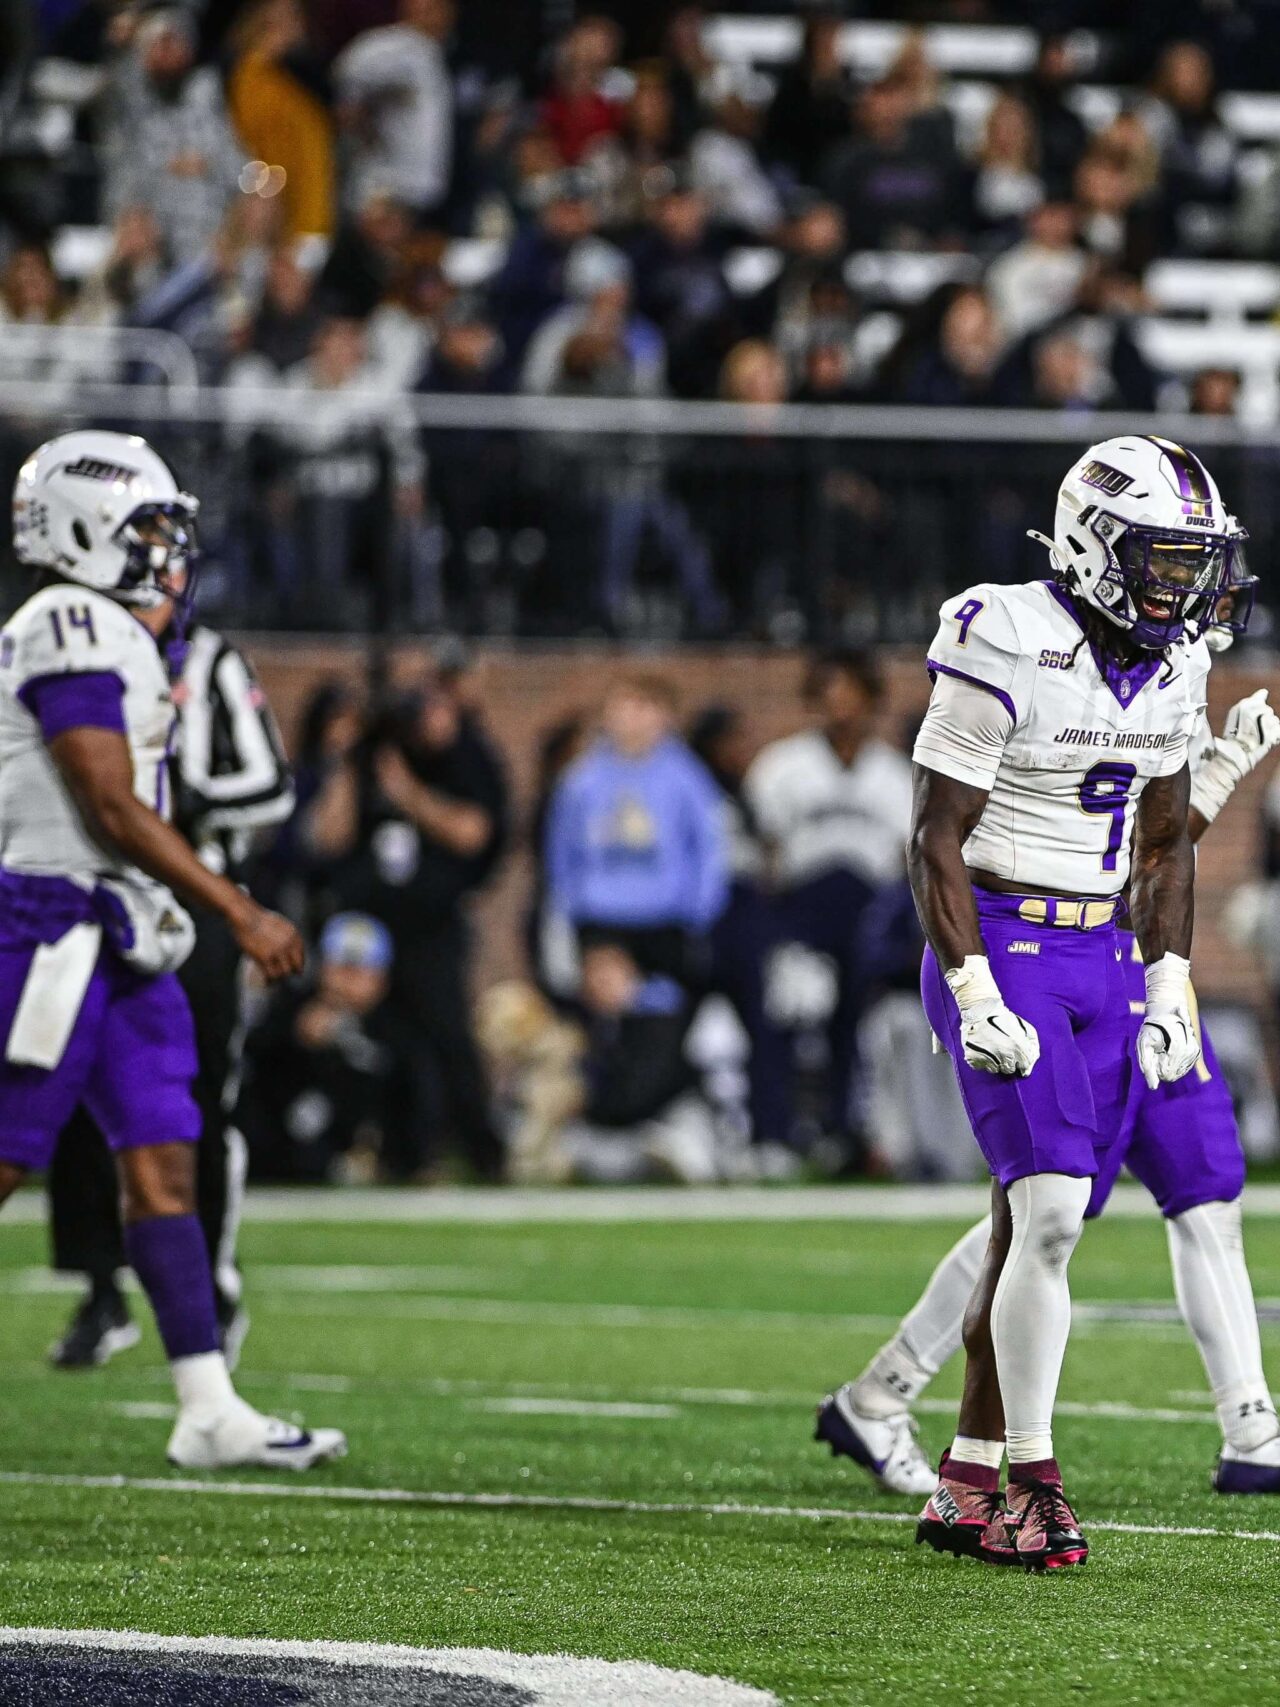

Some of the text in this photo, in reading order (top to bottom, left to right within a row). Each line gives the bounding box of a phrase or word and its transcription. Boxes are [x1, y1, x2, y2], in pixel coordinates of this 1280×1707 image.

[1185, 515, 1216, 529] DUKES
[49, 604, 97, 649] 14
[953, 599, 987, 648] 9
[1038, 649, 1074, 671] SBC
[1054, 727, 1168, 749] JAMES MADISON
[1076, 758, 1139, 874] 9
[1008, 941, 1040, 955] JMU
[934, 1487, 963, 1526] NIKE
